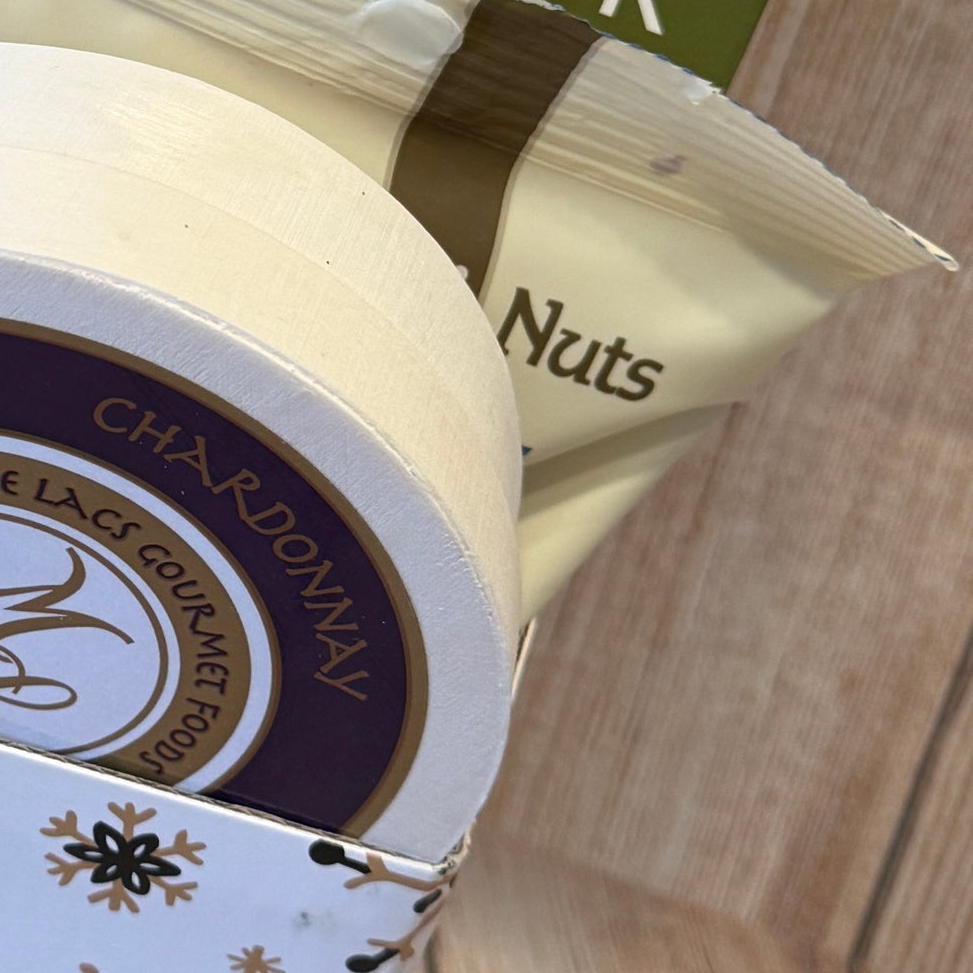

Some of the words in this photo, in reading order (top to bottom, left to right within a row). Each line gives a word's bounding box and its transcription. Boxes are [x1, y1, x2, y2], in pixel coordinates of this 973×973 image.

[497, 286, 664, 401] Nuts
[35, 478, 142, 541] LACS
[93, 397, 370, 702] CHARDONNAY
[138, 544, 231, 696] GOURMET
[140, 697, 220, 775] FOODS
